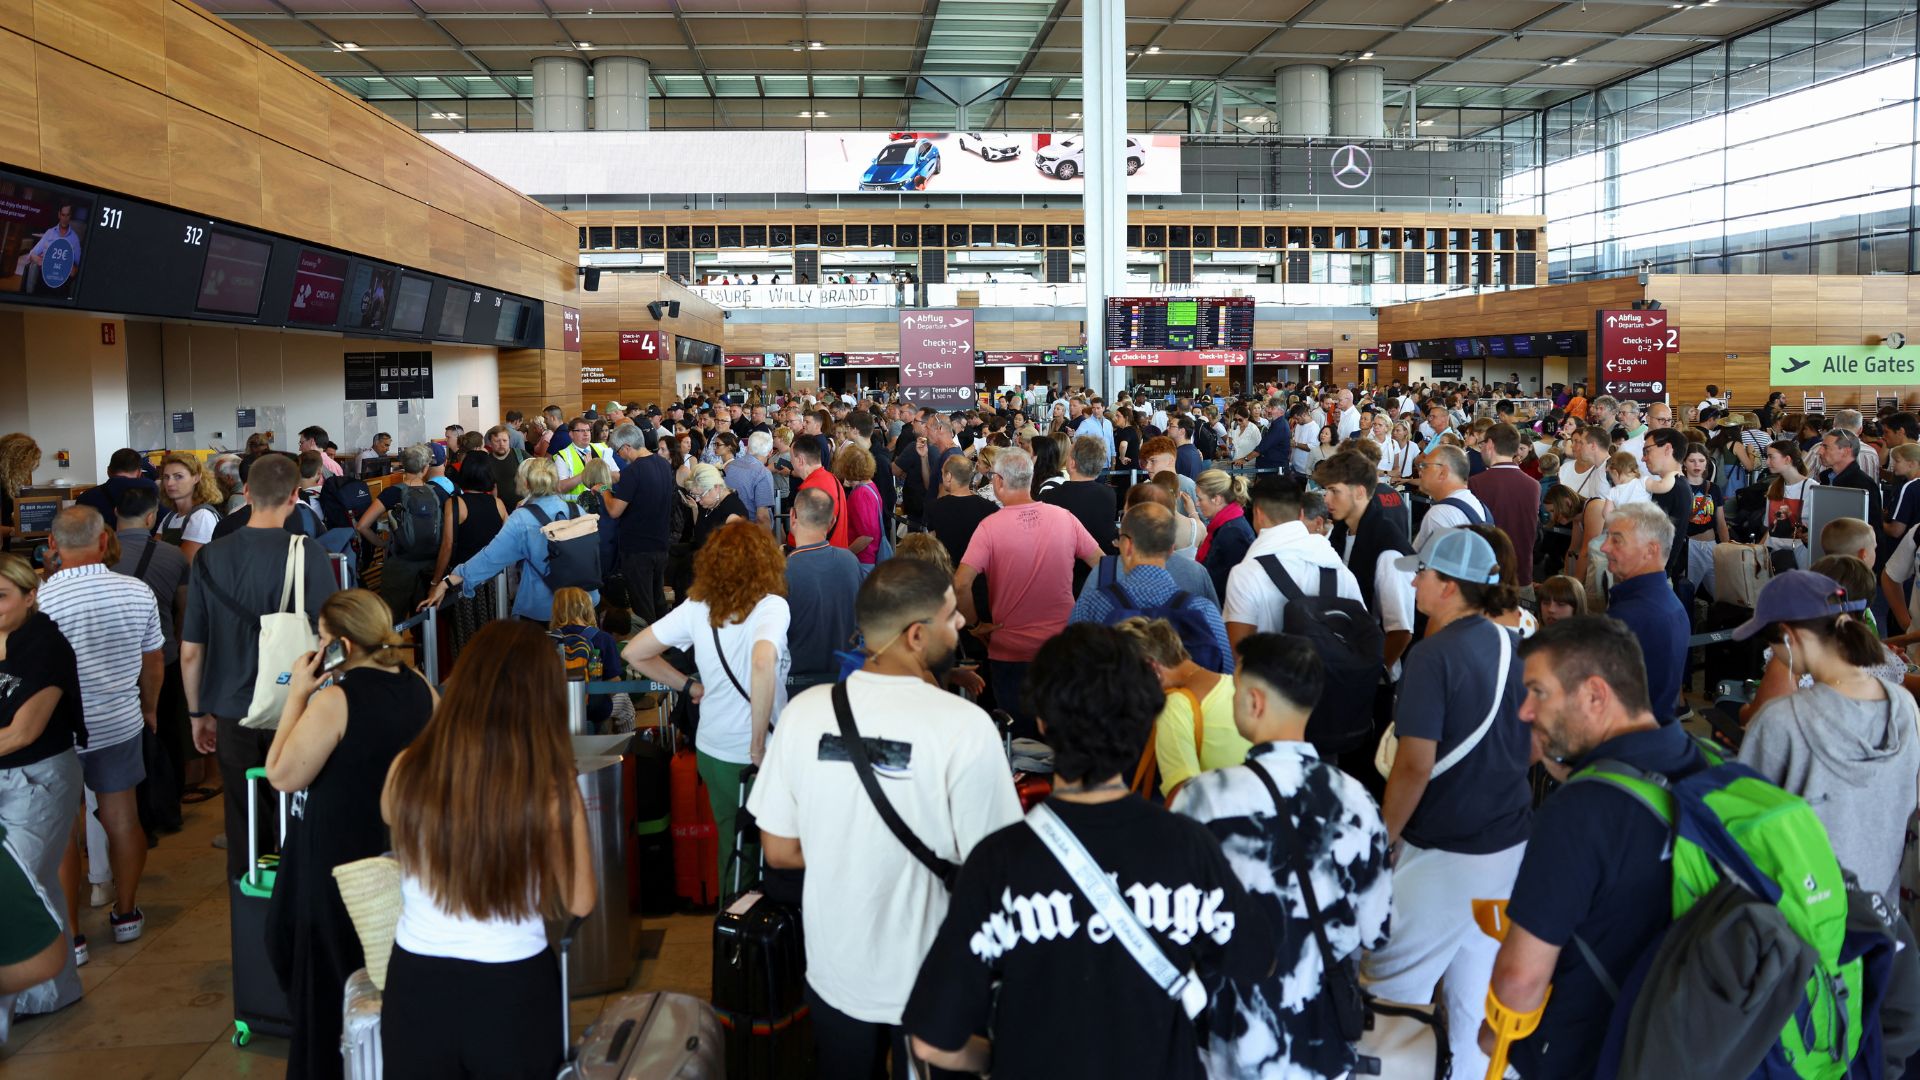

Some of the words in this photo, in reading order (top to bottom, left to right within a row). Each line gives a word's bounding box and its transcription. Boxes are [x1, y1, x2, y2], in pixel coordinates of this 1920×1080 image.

[100, 207, 122, 229] 311
[184, 226, 203, 245] 312
[52, 247, 69, 261] 29€
[769, 287, 812, 303] WILLY
[821, 289, 878, 303] BRANDT
[917, 314, 944, 323] Abflug
[1618, 314, 1642, 323] Abflug
[917, 323, 947, 331] Departure
[641, 334, 656, 354] 4
[922, 339, 957, 347] Check-in
[1666, 329, 1678, 348] 2
[1387, 343, 1392, 357] 2
[1823, 355, 1858, 373] Alle
[1865, 356, 1915, 373] Gates
[918, 370, 934, 378] 3–9
[961, 389, 969, 397] T2
